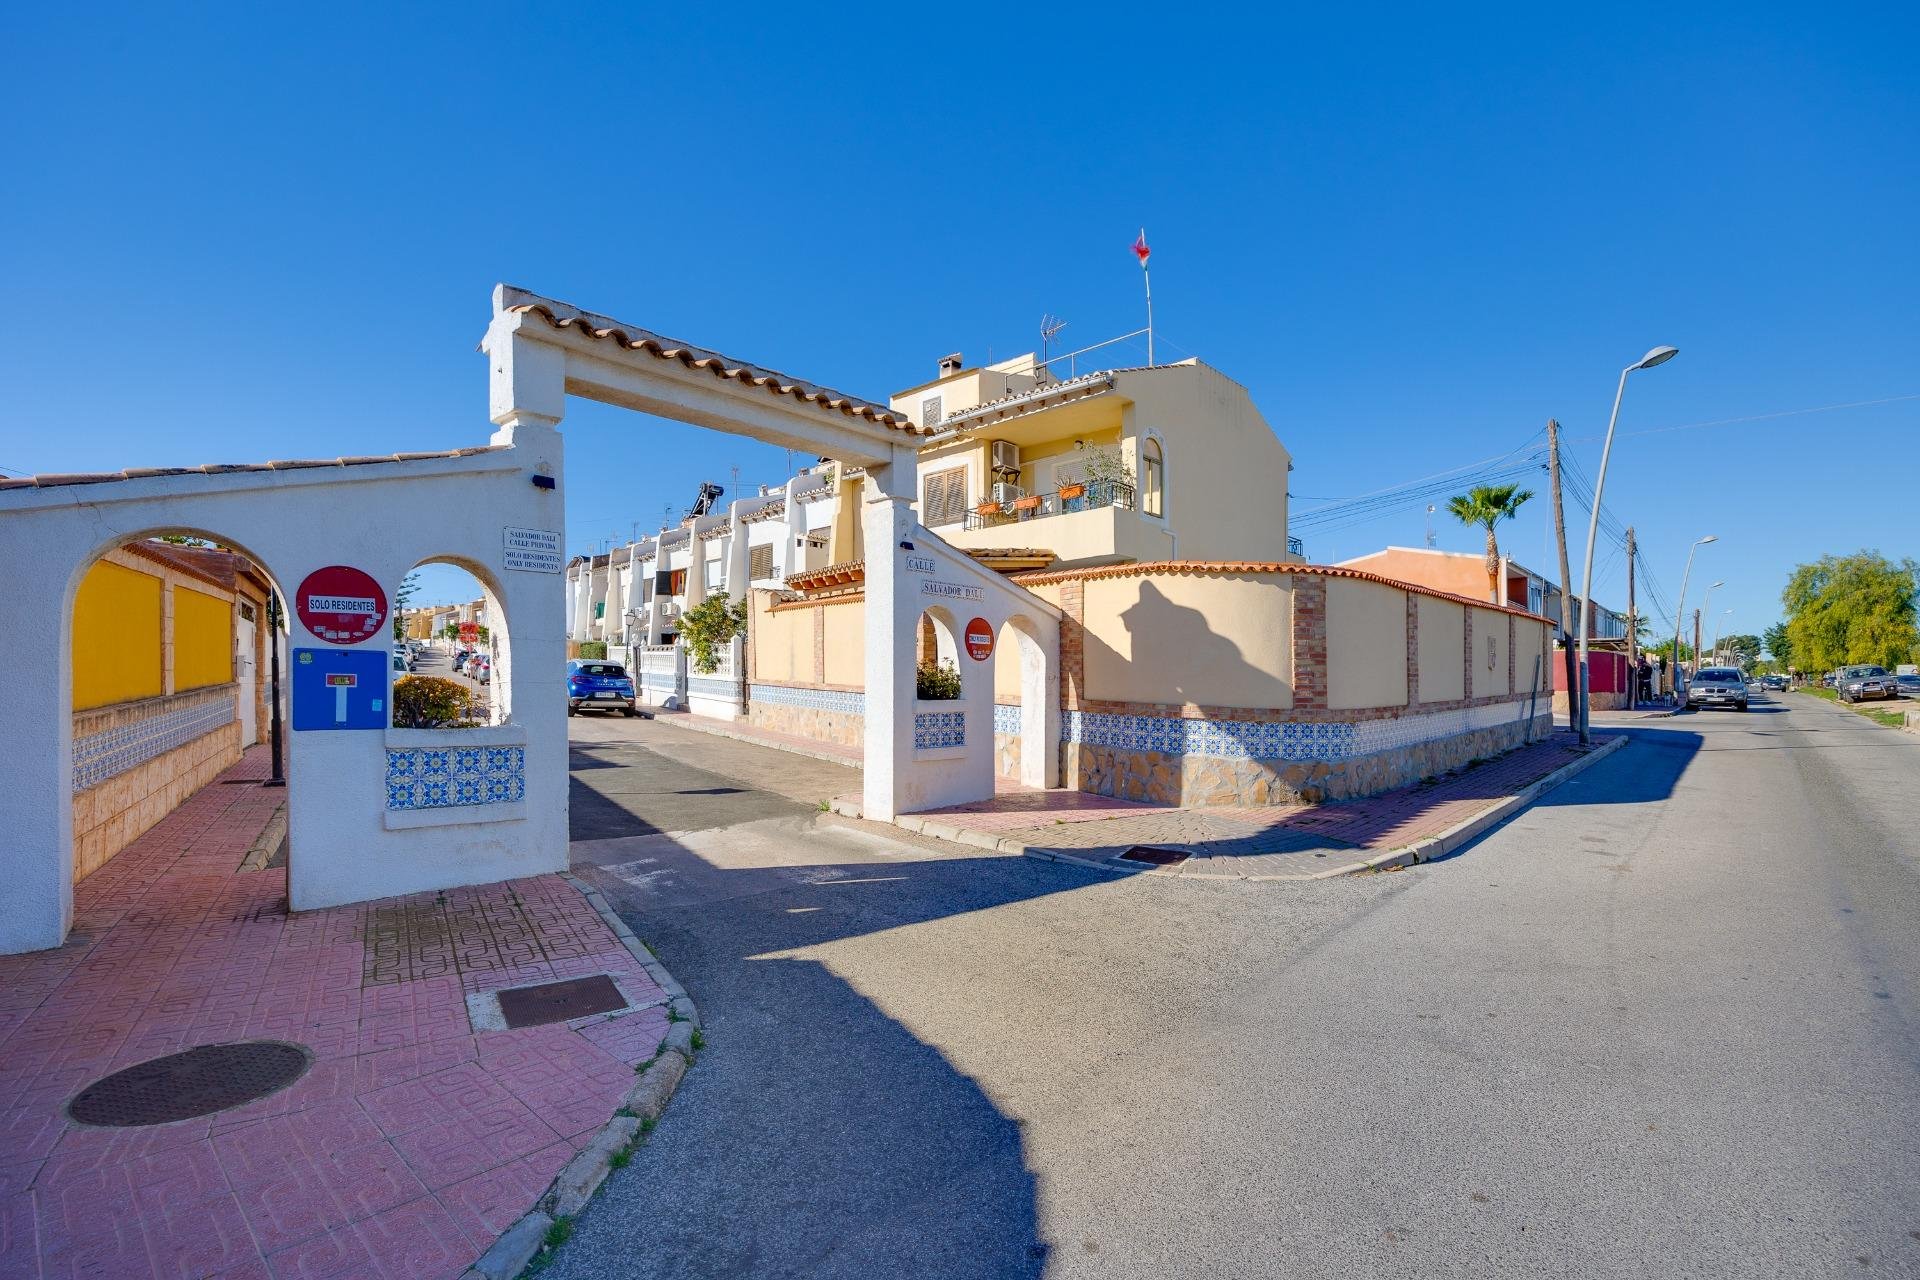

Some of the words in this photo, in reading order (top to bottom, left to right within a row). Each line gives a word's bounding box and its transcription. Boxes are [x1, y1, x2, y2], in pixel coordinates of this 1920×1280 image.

[510, 532, 540, 540] SALVADOR
[531, 542, 556, 550] PRIVADA
[523, 553, 560, 562] RESIDENTES
[525, 562, 558, 570] RESIDENTS
[908, 560, 934, 572] CALLE
[924, 582, 962, 596] SALVADOR
[310, 600, 330, 610] SOLO
[332, 600, 374, 611] RESIDENTES
